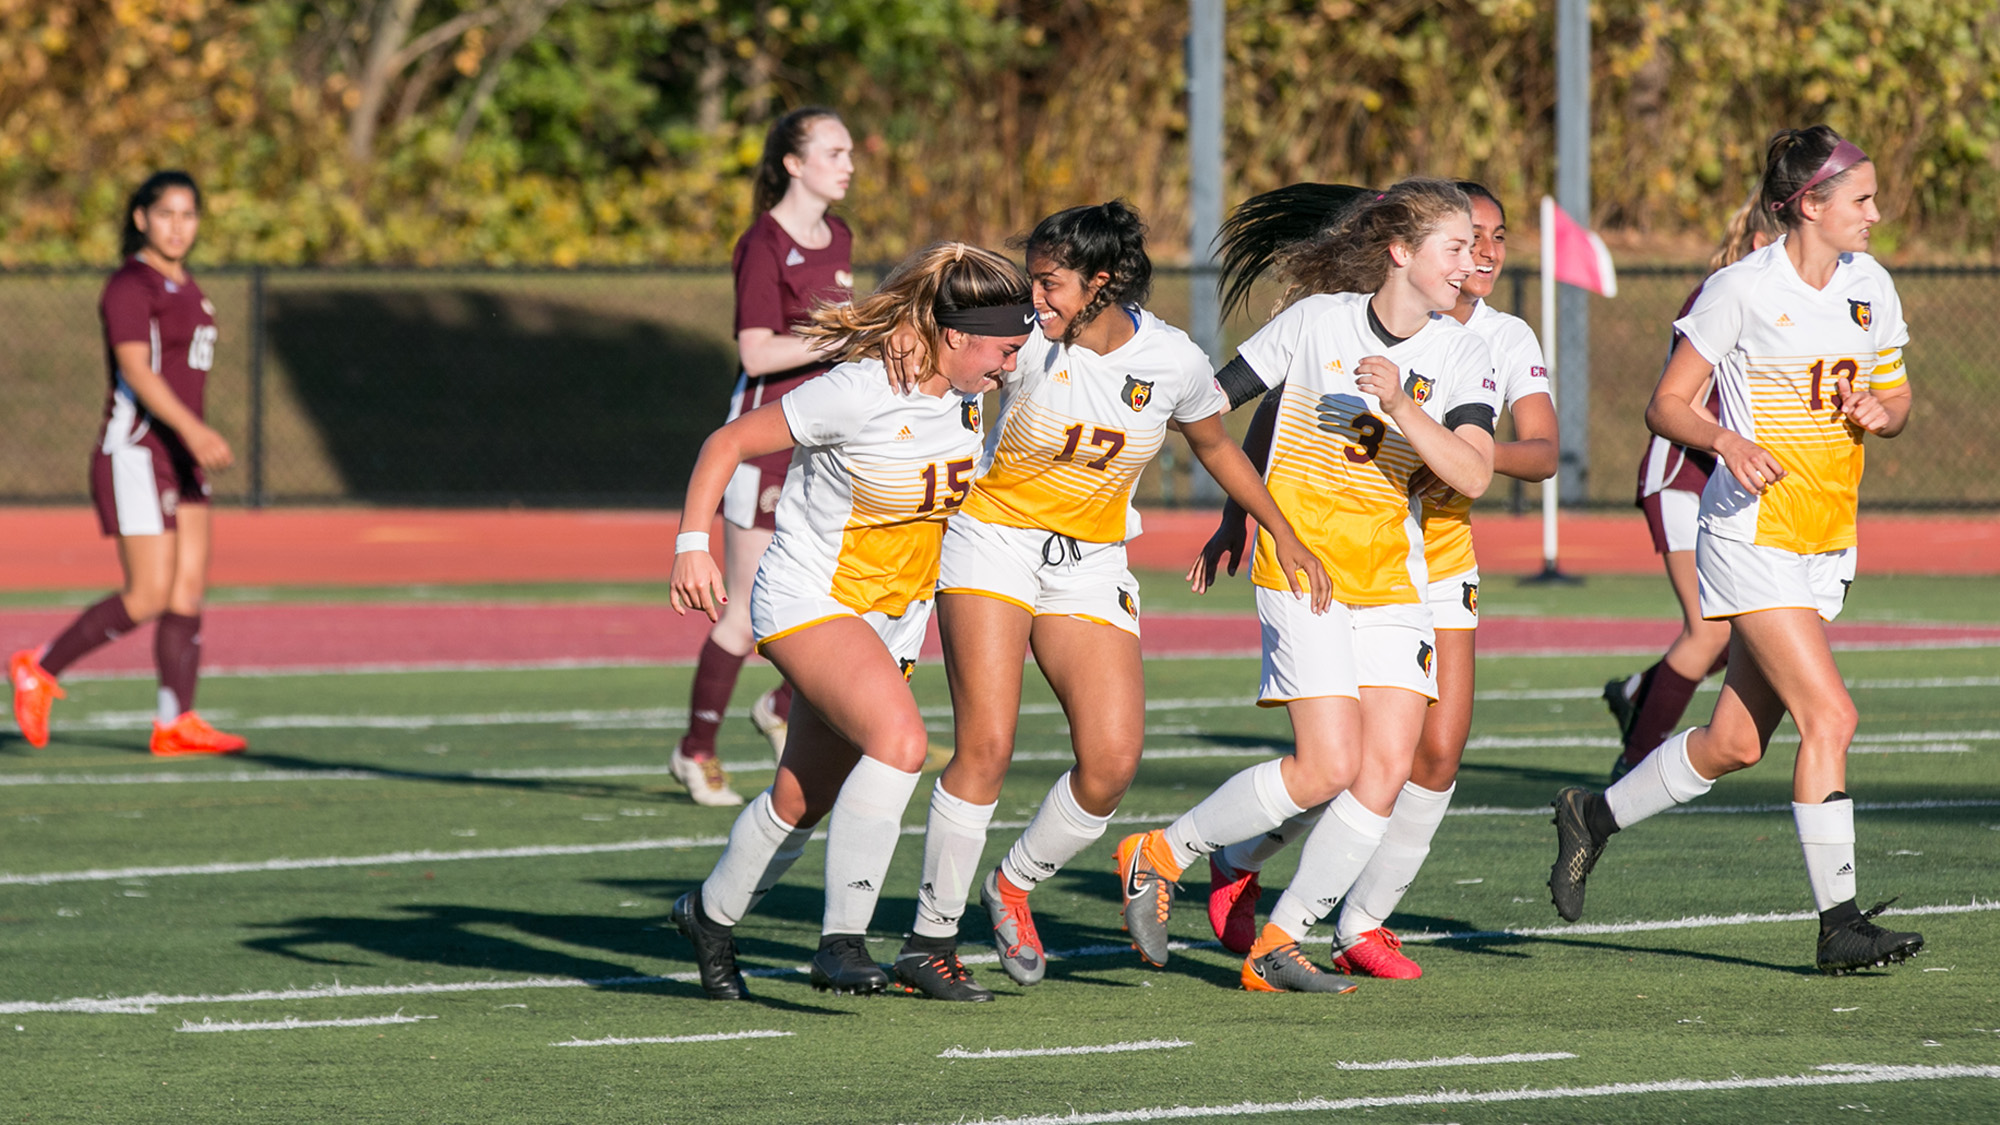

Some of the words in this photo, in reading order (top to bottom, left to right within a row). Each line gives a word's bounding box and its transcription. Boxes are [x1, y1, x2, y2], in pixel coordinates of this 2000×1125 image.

[1807, 358, 1858, 412] 13
[1052, 423, 1127, 473] 17
[1343, 411, 1389, 465] 3
[915, 457, 975, 514] 15
